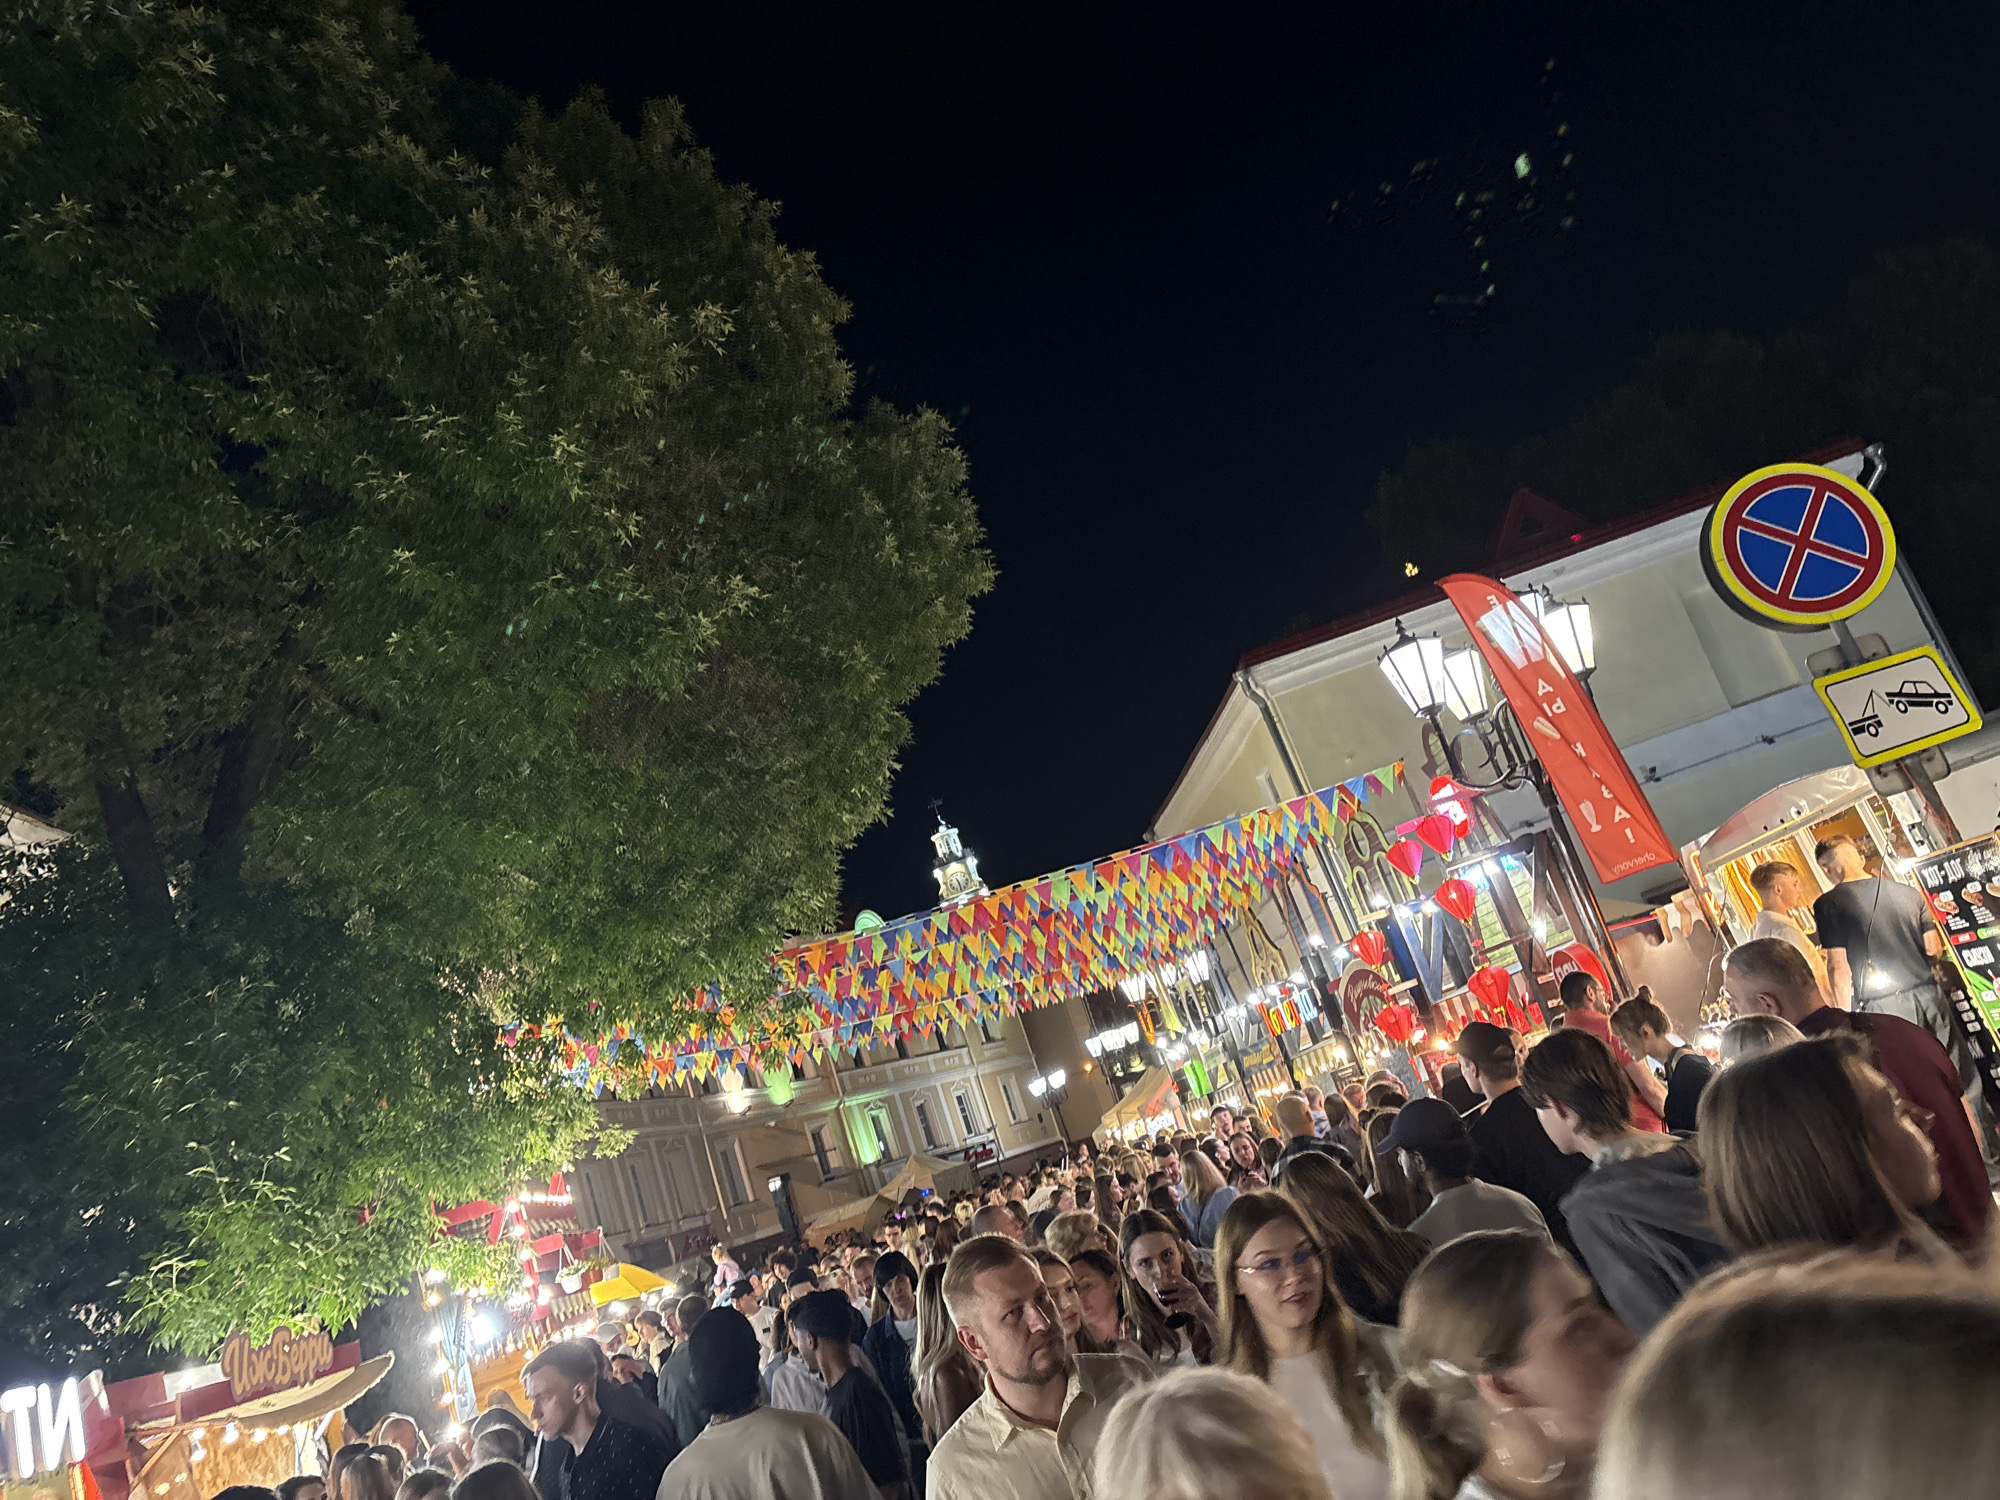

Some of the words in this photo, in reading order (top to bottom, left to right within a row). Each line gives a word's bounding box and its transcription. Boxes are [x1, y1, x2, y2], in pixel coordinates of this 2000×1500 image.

[1921, 858, 1965, 888] ХОТ-ДОГ
[223, 1330, 333, 1396] ИжБерри
[0, 1376, 86, 1479] ТИ
